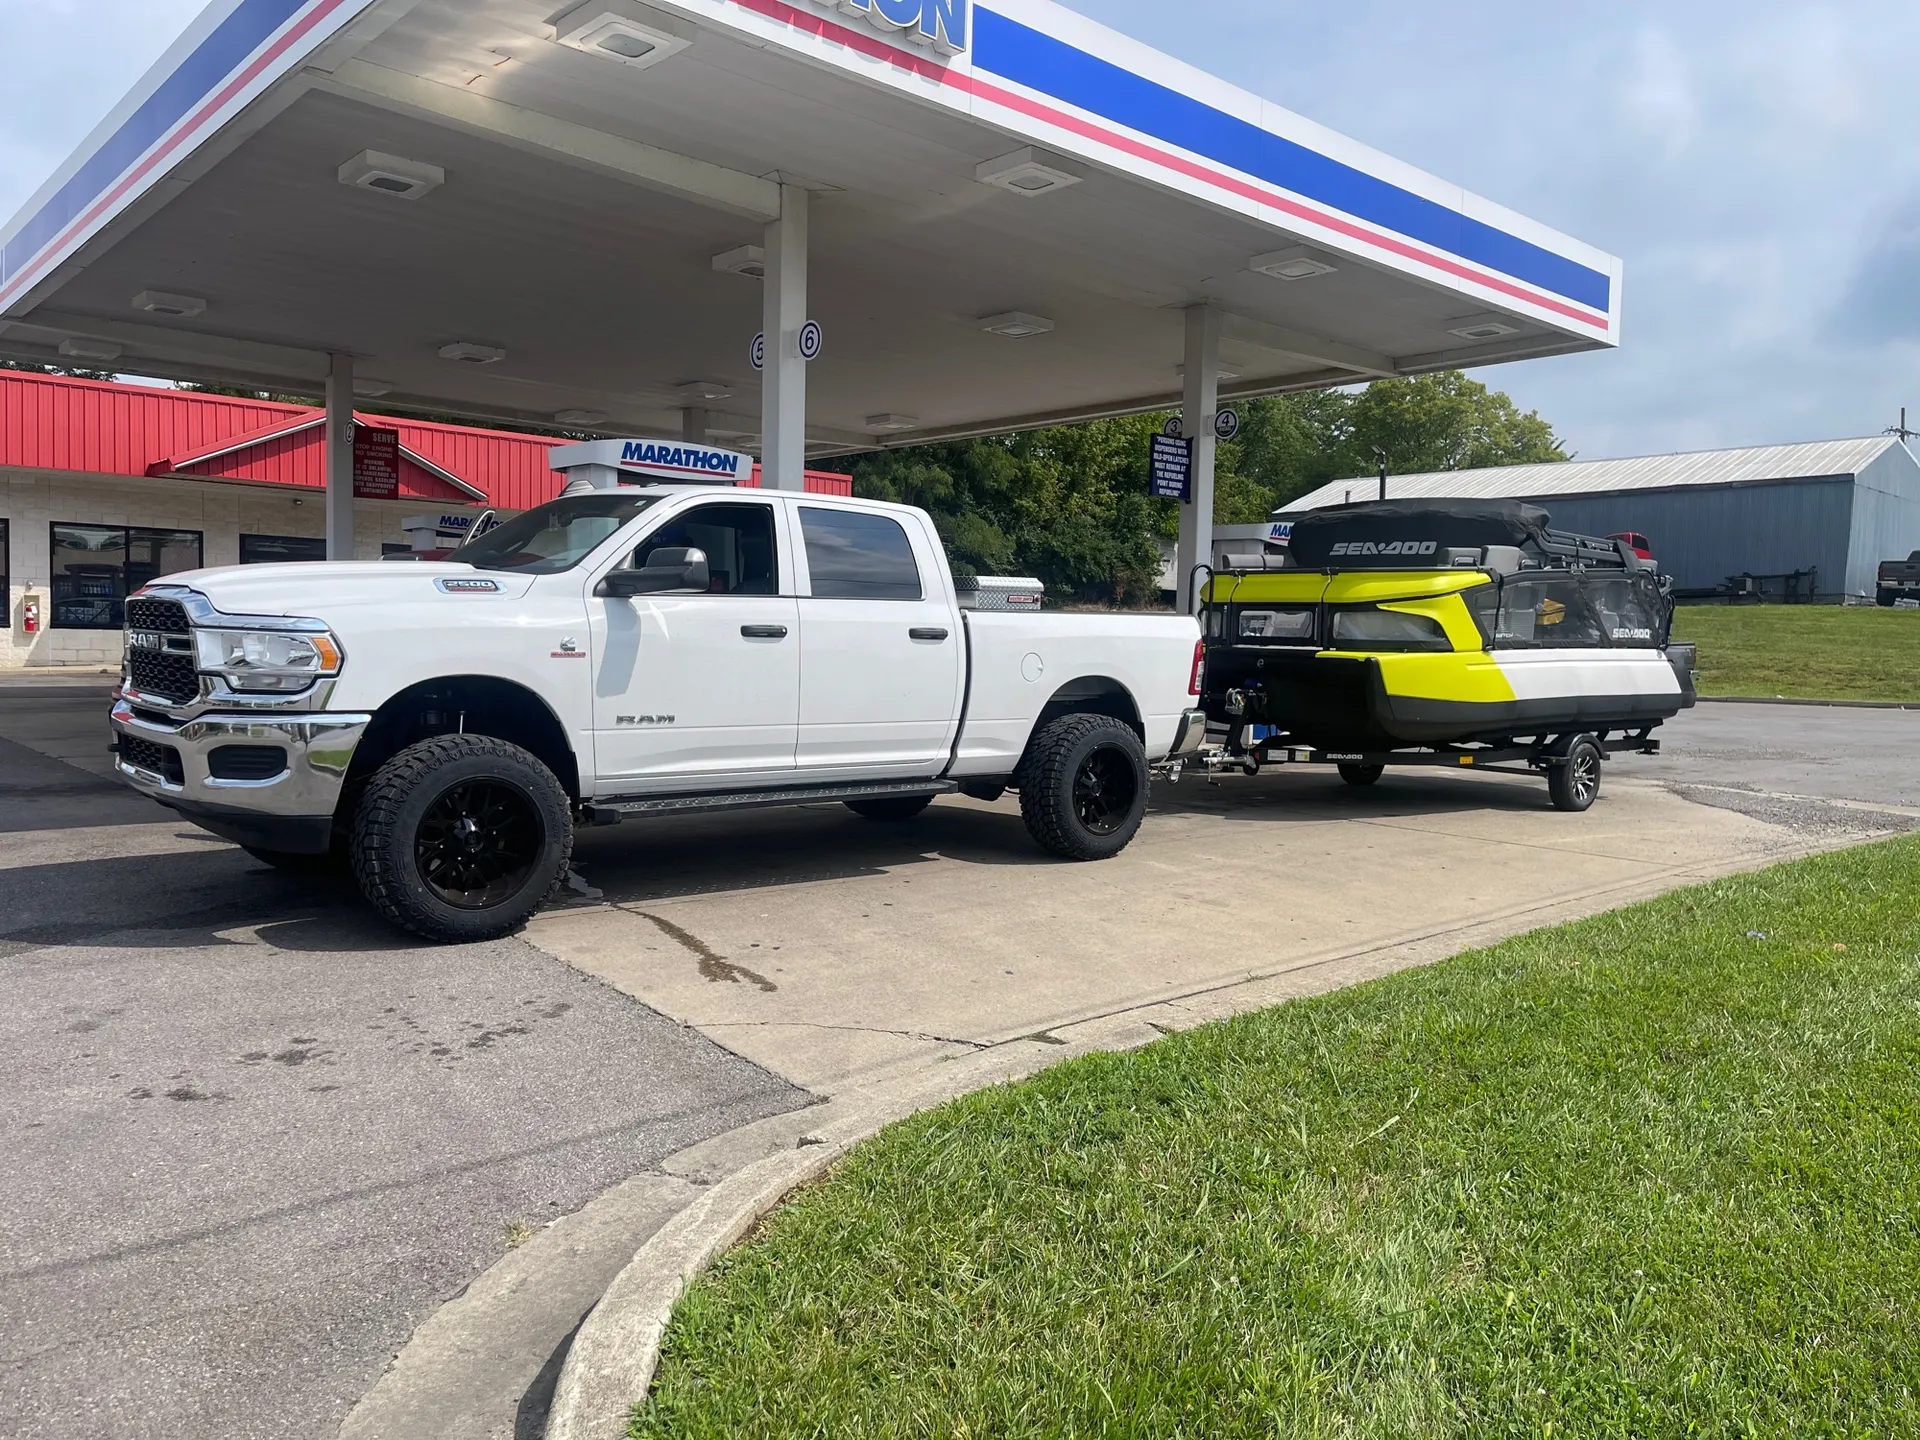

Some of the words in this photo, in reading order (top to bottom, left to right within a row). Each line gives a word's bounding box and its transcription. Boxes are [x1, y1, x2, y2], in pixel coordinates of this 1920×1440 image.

[805, 329, 815, 350] 6
[372, 432, 396, 444] SERVE
[621, 441, 738, 473] MARATHON
[1166, 463, 1180, 471] REMAIN
[129, 633, 160, 649] RAM
[615, 714, 676, 725] RAM
